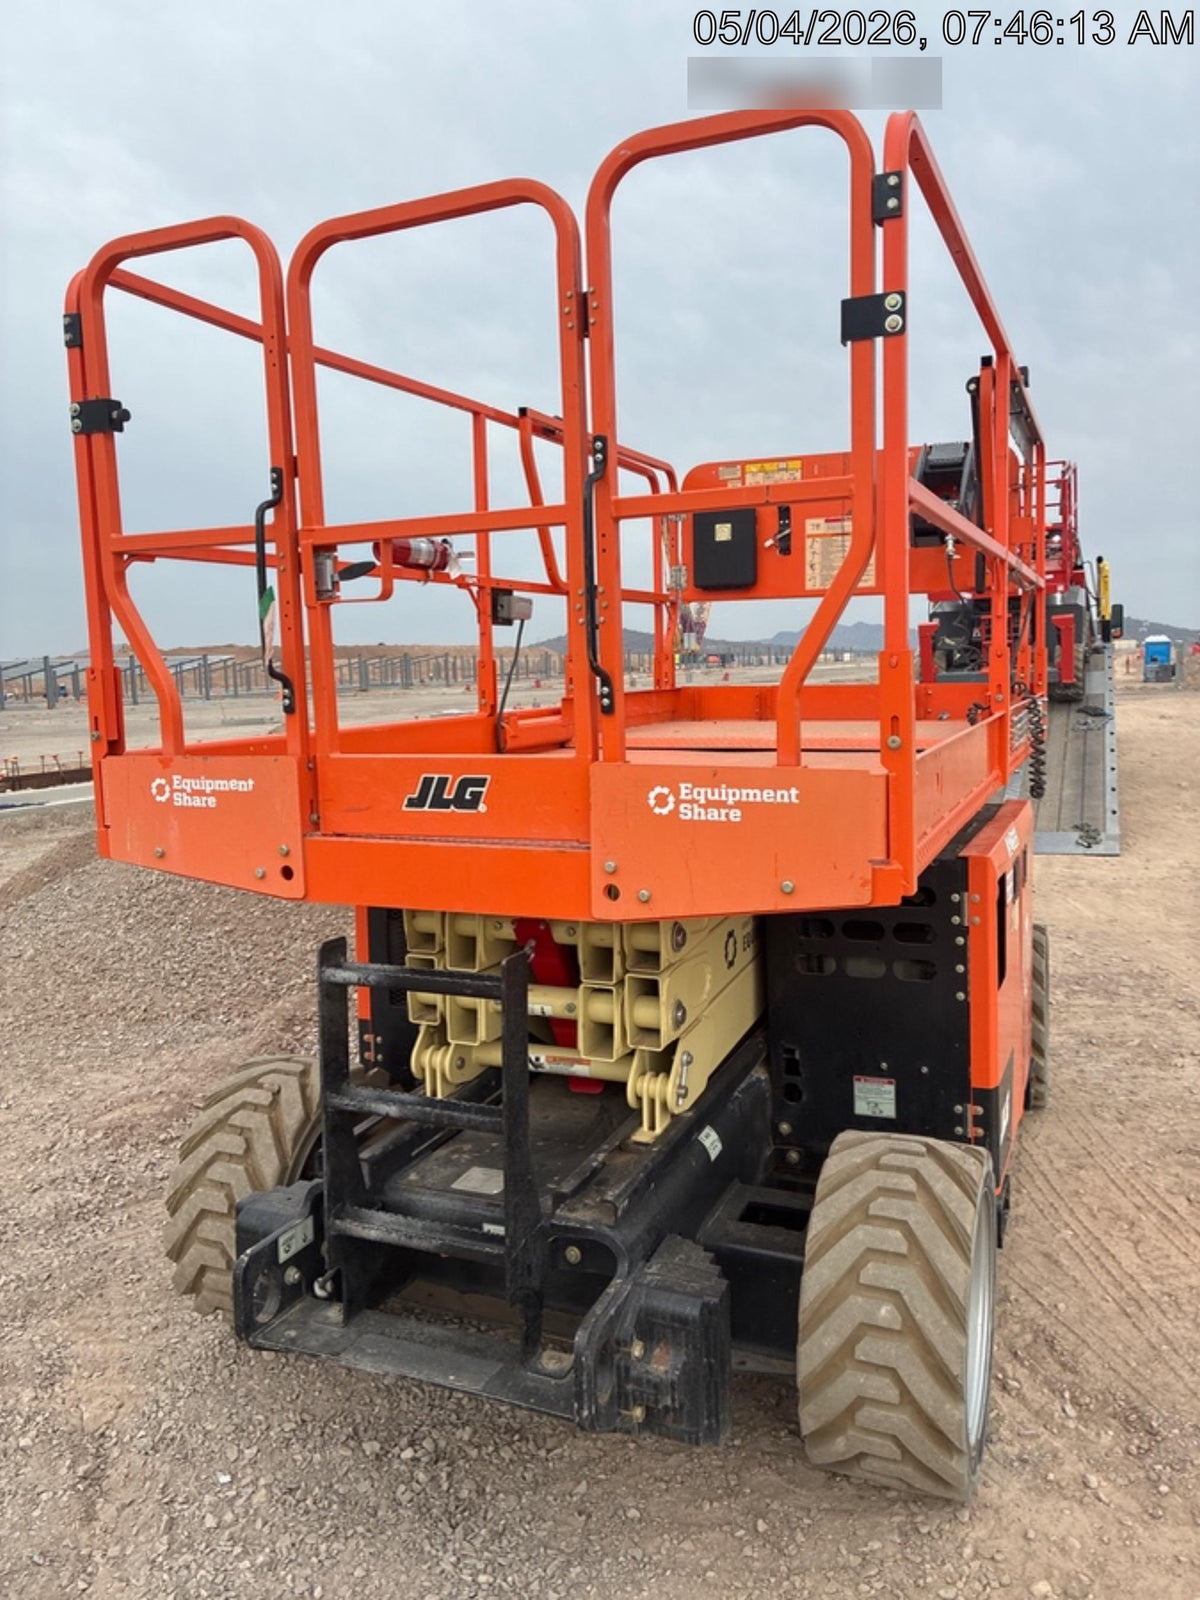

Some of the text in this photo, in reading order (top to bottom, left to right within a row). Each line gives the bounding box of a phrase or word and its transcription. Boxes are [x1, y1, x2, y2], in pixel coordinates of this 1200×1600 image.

[171, 775, 255, 794] Equipment
[402, 774, 491, 813] JLG
[678, 782, 800, 805] Equipment
[173, 791, 217, 808] Share
[678, 803, 742, 822] Share
